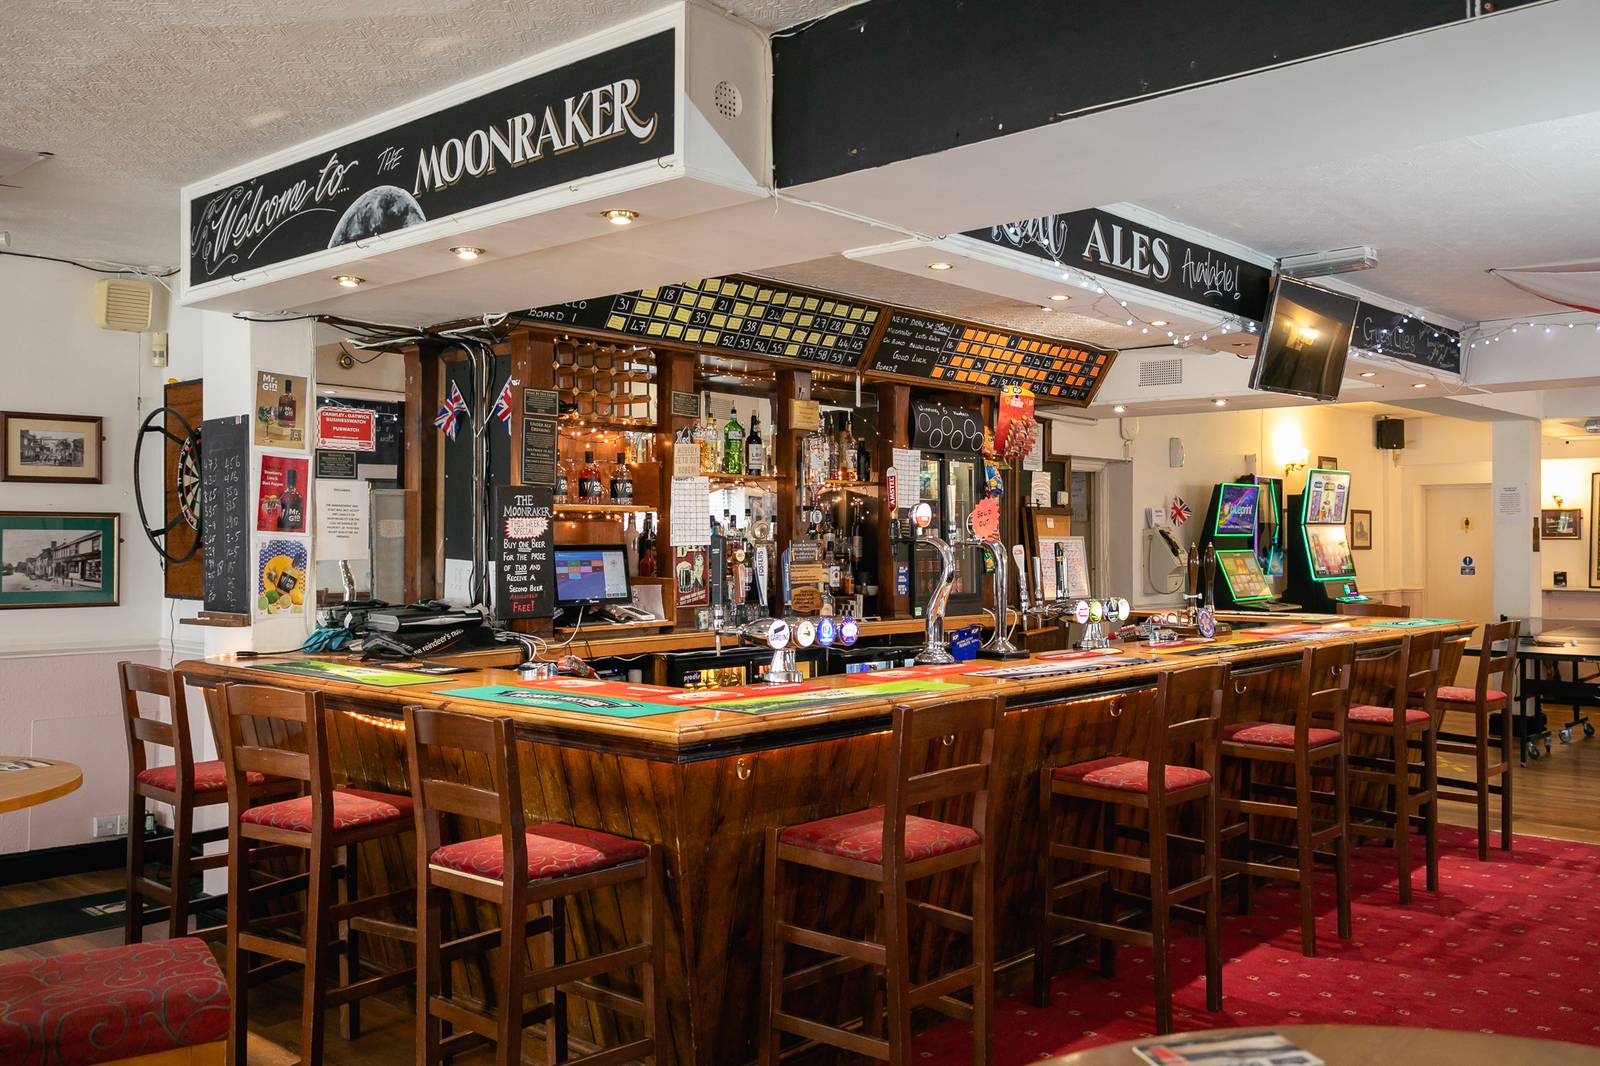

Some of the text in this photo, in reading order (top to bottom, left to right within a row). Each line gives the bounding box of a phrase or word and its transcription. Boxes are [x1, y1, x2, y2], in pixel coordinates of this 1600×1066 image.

[411, 78, 658, 200] MOONRAKER
[376, 145, 405, 176] THE
[208, 180, 315, 262] Welcome
[1081, 217, 1173, 283] ALES
[1180, 247, 1242, 301] Available!
[664, 288, 675, 300] 18
[527, 307, 564, 320] BOARD
[616, 298, 871, 336] 31 21 24 27 28 30
[892, 315, 909, 324] NEXT
[630, 312, 864, 350] 47 35 38 44 45
[722, 336, 842, 363] 52 53 54 55 57 58 59
[262, 374, 278, 384] Mr.
[262, 383, 278, 392] Gin
[942, 406, 948, 414] 6
[514, 494, 534, 506] THE
[502, 505, 553, 518] MOONRAKER
[503, 538, 517, 549] BUY
[531, 538, 546, 548] BEER
[503, 552, 514, 561] FOR
[530, 552, 546, 560] PRICE
[506, 574, 528, 582] RECEIVE
[509, 584, 528, 592] SECOND
[512, 600, 536, 613] FREE!
[422, 633, 452, 652] reindeer's
